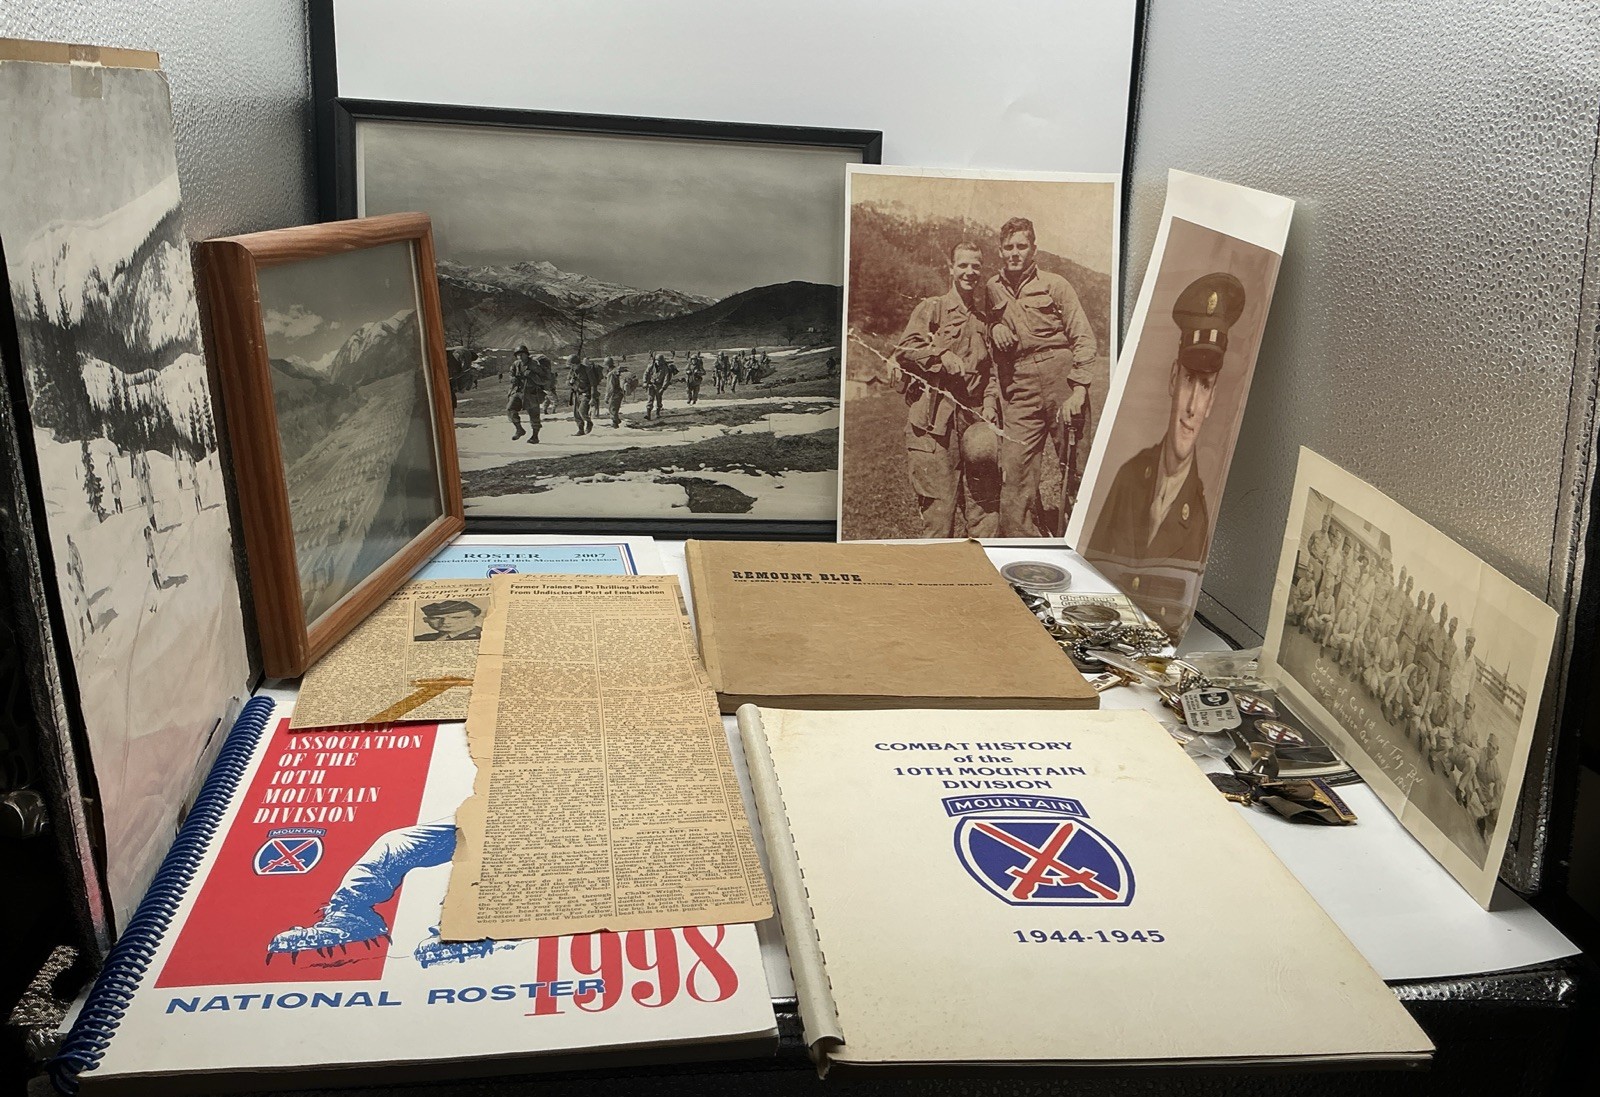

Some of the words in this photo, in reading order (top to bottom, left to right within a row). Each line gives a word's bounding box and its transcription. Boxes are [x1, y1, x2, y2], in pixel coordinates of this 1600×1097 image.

[732, 571, 812, 580] REMOUNT
[819, 574, 861, 582] BLUE
[285, 735, 423, 750] ASSOCIATION
[874, 742, 970, 751] COMBAT
[976, 742, 1073, 751] HISTORY
[278, 753, 307, 767] OF
[314, 752, 359, 767] THE
[953, 754, 974, 763] of
[978, 754, 1014, 763] the
[271, 770, 326, 784] 10TH
[892, 767, 952, 776] 10TH
[958, 766, 1087, 776] MOUNTAIN
[942, 780, 1052, 789] DIVISION
[262, 786, 381, 804] MOUNTAIN
[954, 798, 1076, 812] MOUNTAIN
[253, 806, 358, 824] DIVISION
[1012, 930, 1166, 943] 1944-1945
[523, 923, 741, 1017] 1998
[165, 988, 403, 1015] NATIONAL
[427, 977, 609, 1006] ROSTER
